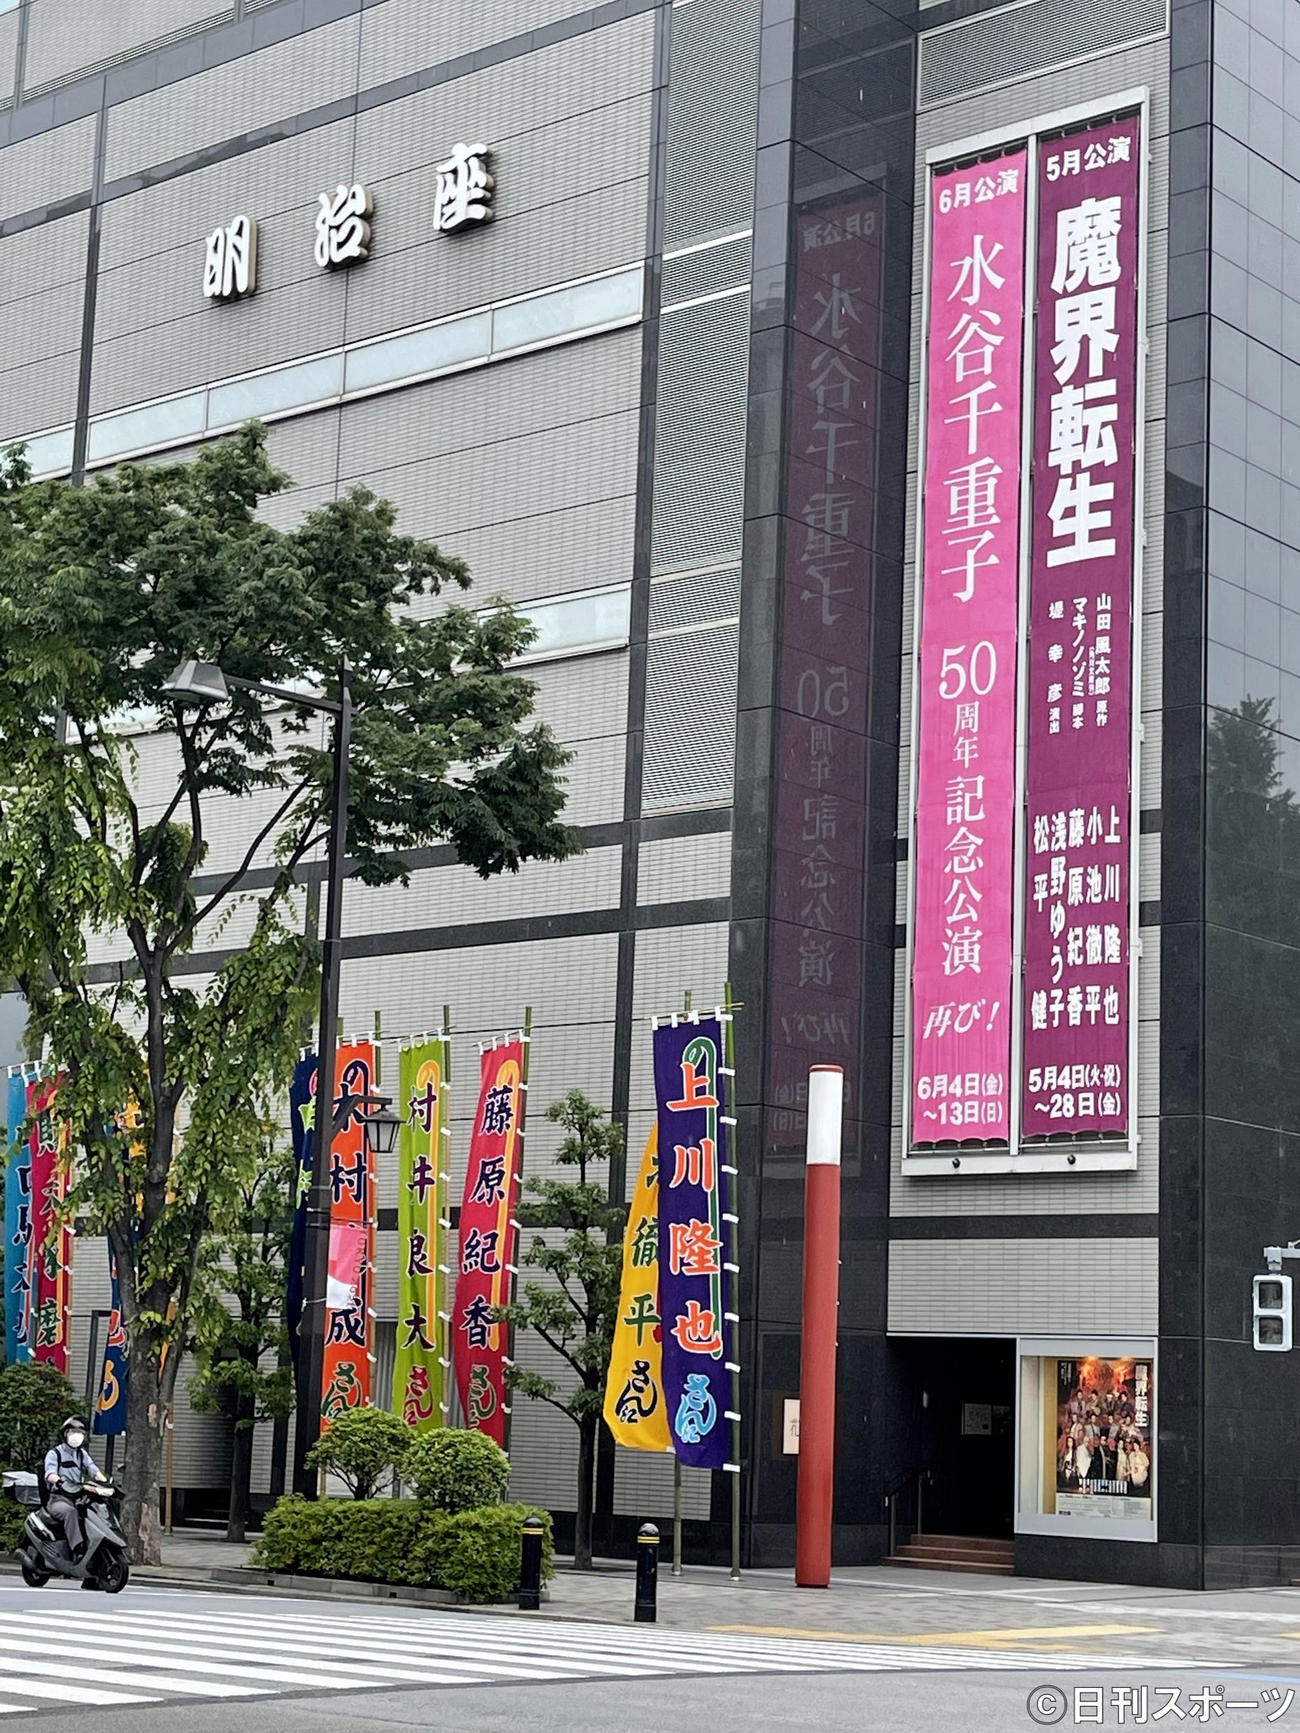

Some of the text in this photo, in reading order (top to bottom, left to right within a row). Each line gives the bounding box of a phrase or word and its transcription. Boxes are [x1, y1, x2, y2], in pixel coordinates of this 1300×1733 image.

[203, 142, 493, 297] 明治座
[938, 168, 1020, 214] 6月公演
[1046, 136, 1132, 182] 5月公演
[941, 234, 1006, 603] 水谷千重子
[1047, 196, 1122, 568] 魔界転生
[1031, 815, 1049, 1031] 松平健
[1049, 811, 1067, 1028] 浅野ゆう子
[1067, 808, 1085, 1027] 藤原紀香
[1085, 806, 1104, 1025] 小池徹平
[1104, 805, 1121, 1025] 上川隆也
[917, 1073, 1003, 1100] 6月4日(金)
